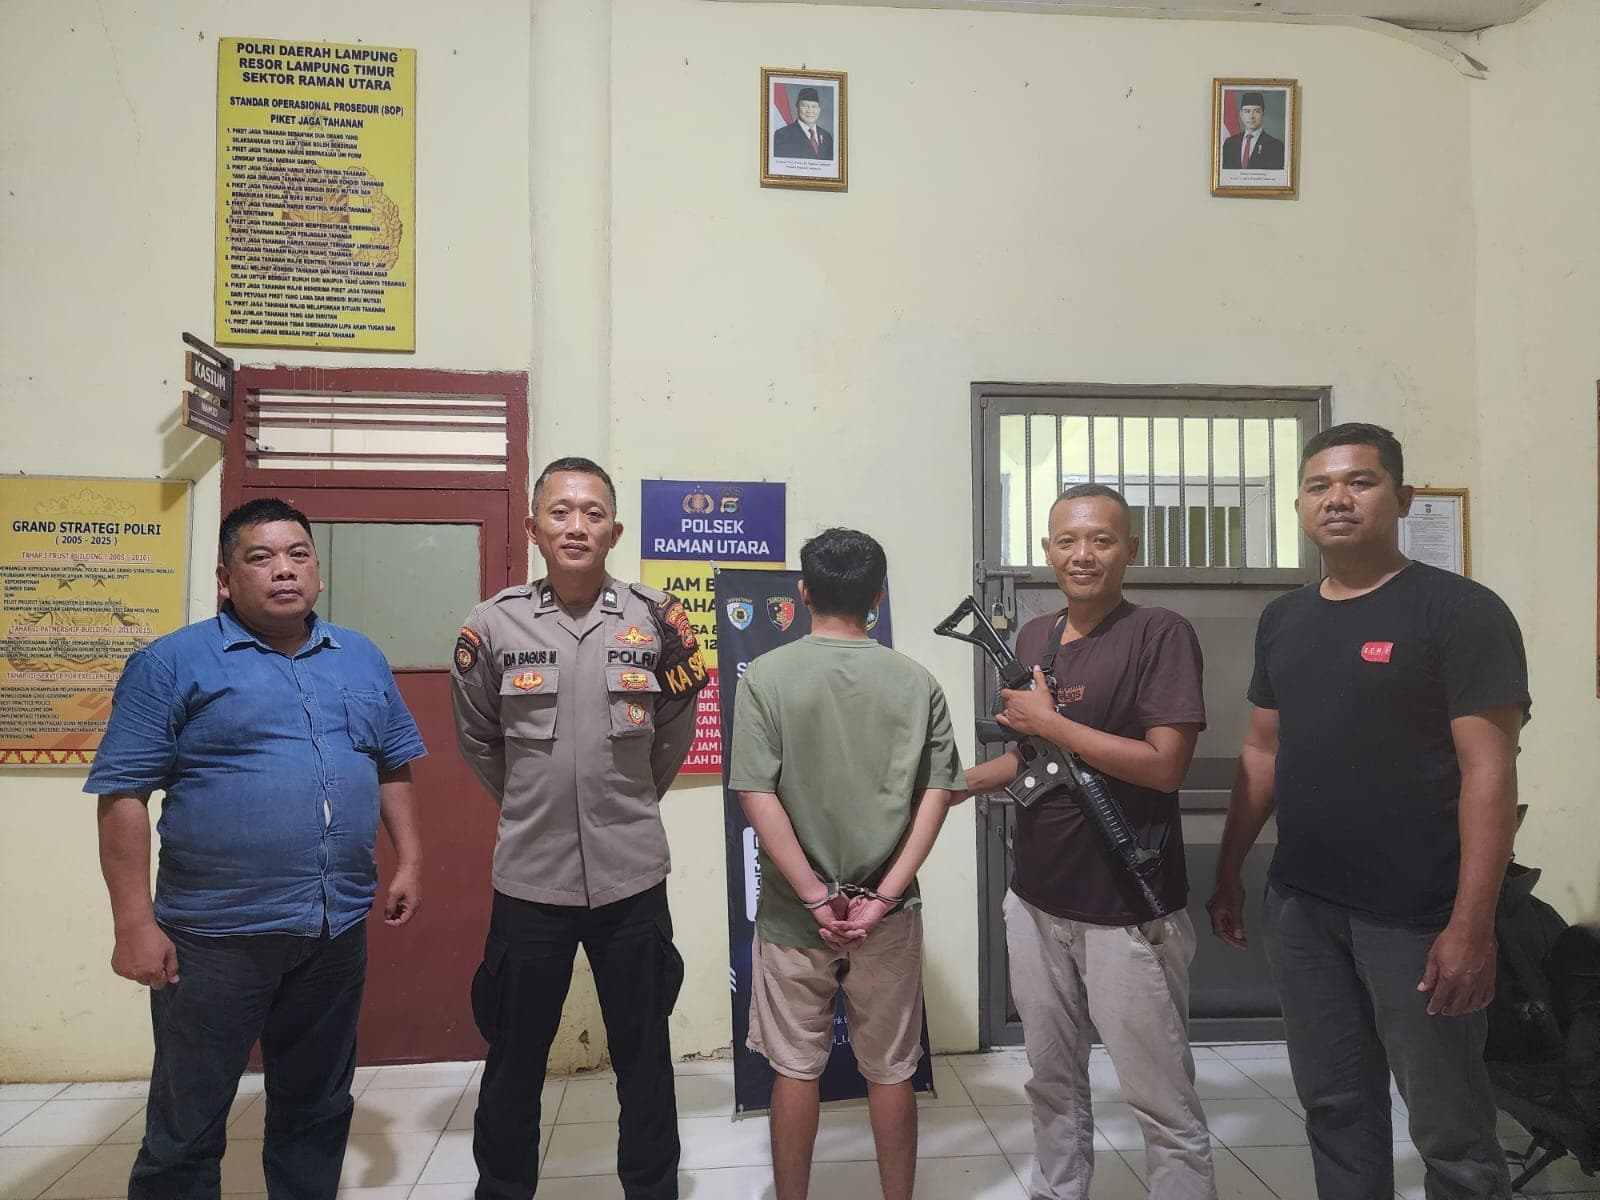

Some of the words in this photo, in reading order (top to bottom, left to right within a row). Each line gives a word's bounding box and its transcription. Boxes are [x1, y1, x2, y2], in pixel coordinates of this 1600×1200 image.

[237, 43, 274, 55] POLRI
[280, 45, 330, 58] DAERAH
[335, 49, 398, 62] LAMPUNG
[239, 58, 282, 70] RESOR
[287, 60, 349, 74] LAMPUNG
[354, 64, 394, 77] TIMUR
[243, 72, 294, 85] SEKTOR
[299, 75, 344, 88] RAMAN
[350, 78, 391, 91] UTARA
[230, 96, 269, 107] STANDAR
[272, 99, 331, 111] OPERASIONAL
[334, 103, 379, 114] PROSEDUR
[382, 106, 403, 117] (SOP)
[271, 114, 296, 124] PIKET
[298, 116, 320, 126] JAGA
[324, 118, 363, 128] TAHANAN
[195, 360, 225, 391] KASIUM
[13, 521, 56, 532] GRAND
[60, 522, 120, 534] STRATEGI
[124, 524, 161, 535] POLRI
[682, 519, 744, 534] POLSEK
[62, 536, 82, 544] 2005
[91, 537, 111, 545] 2025
[655, 539, 713, 553] RAMAN
[718, 540, 770, 554] UTARA
[663, 577, 700, 591] JAM
[682, 598, 715, 612] AHA
[504, 653, 516, 666] IDA
[518, 651, 546, 664] BAGUS
[608, 650, 656, 666] POLRI
[665, 665, 692, 694] KA
[684, 755, 708, 764] LAH
